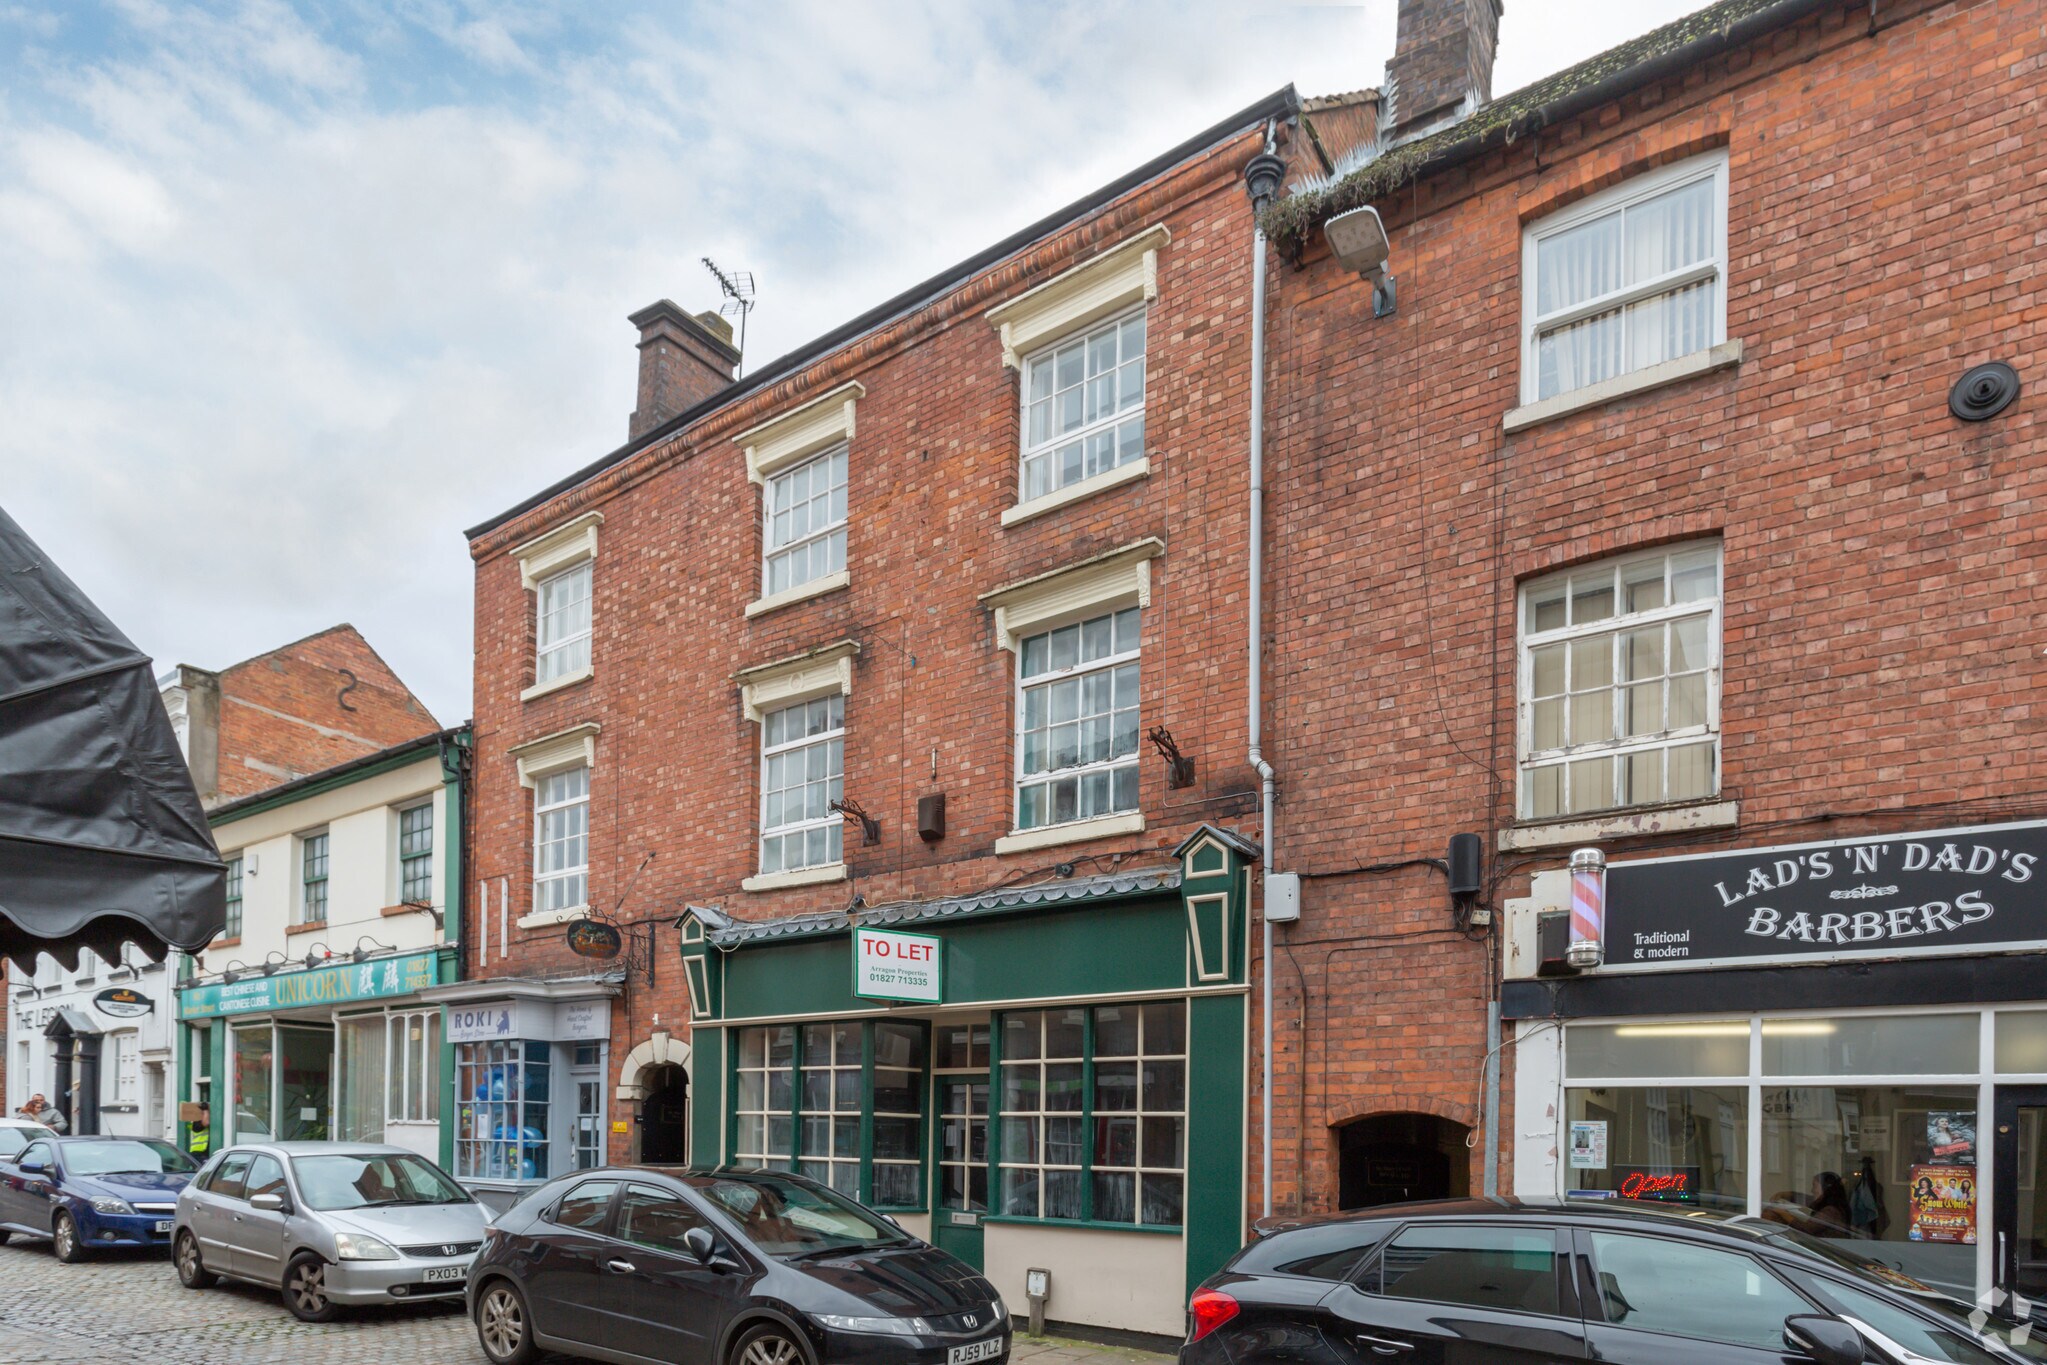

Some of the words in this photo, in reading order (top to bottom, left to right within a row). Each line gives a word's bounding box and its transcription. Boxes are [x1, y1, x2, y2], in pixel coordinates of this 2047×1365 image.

[1714, 850, 1833, 908] LAD'S
[1844, 843, 1889, 875] 'N'
[1902, 842, 2038, 884] DAD'S
[1744, 889, 1994, 945] BARBERS
[1633, 929, 1690, 945] Traditional
[863, 938, 890, 957] TO
[897, 942, 933, 961] LET
[1633, 948, 1645, 959] &
[1647, 945, 1689, 958] modern
[869, 973, 895, 983] 01827
[898, 976, 928, 986] 713335
[897, 968, 928, 977] Properties
[275, 968, 352, 1005] UNICORN
[15, 1010, 34, 1030] THE
[454, 1010, 492, 1029] ROKI
[1622, 1172, 1687, 1199] Open
[428, 1268, 458, 1280] PX03
[953, 1344, 980, 1363] RJ59
[982, 1339, 999, 1356] YLZ
